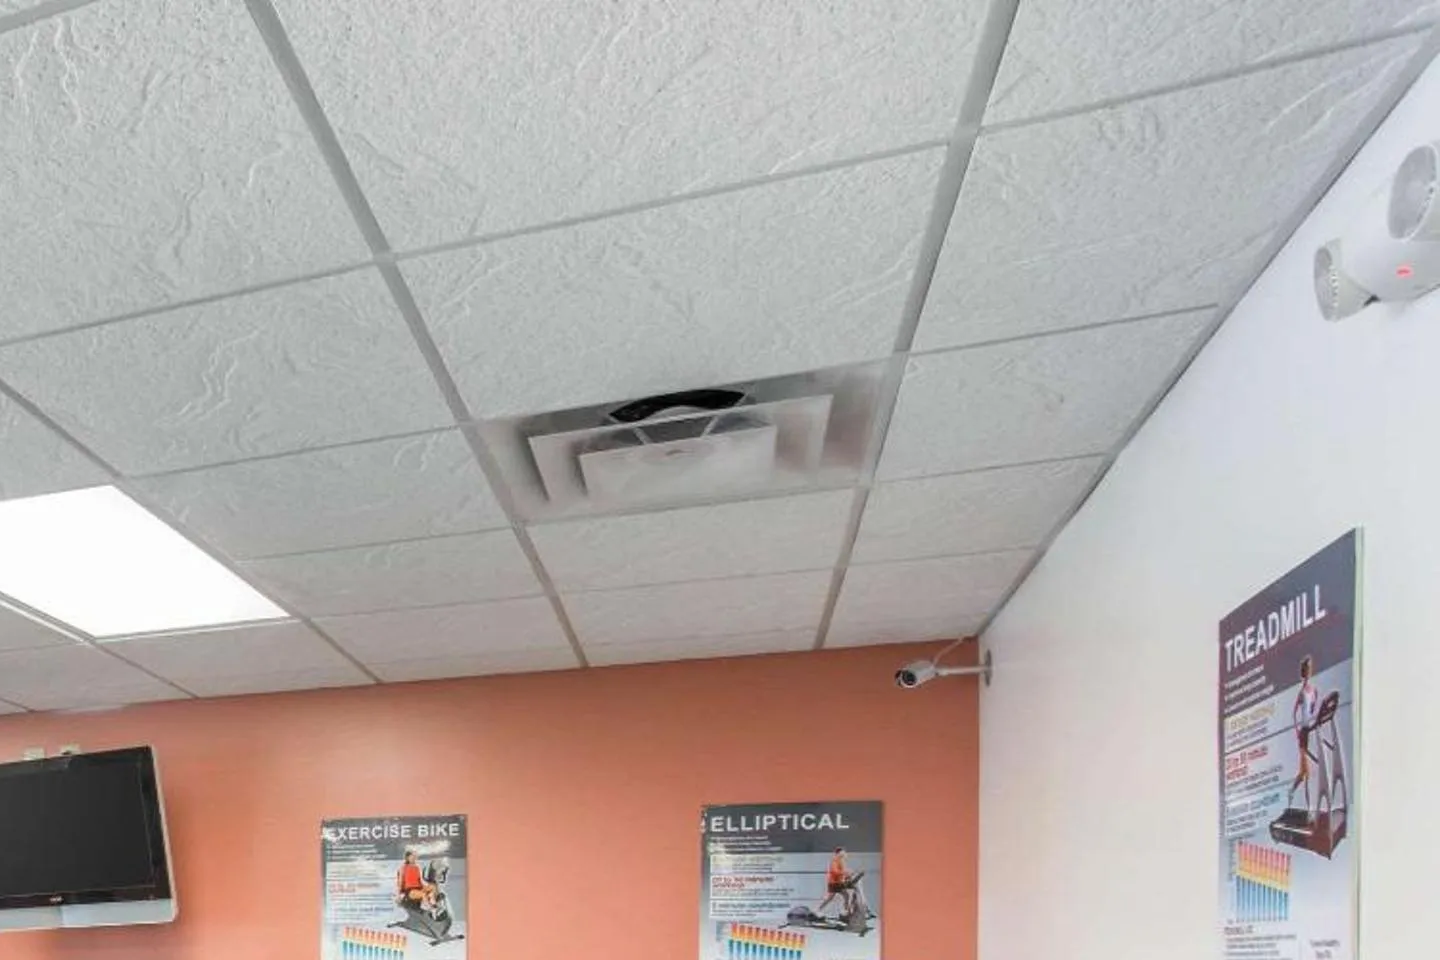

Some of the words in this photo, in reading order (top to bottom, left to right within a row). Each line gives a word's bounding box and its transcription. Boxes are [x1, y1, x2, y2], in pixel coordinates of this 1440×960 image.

[1224, 584, 1328, 673] TREADMILL
[324, 825, 412, 840] EXERCISE
[417, 823, 460, 837] BIKE
[710, 813, 850, 832] ELLIPTICAL
